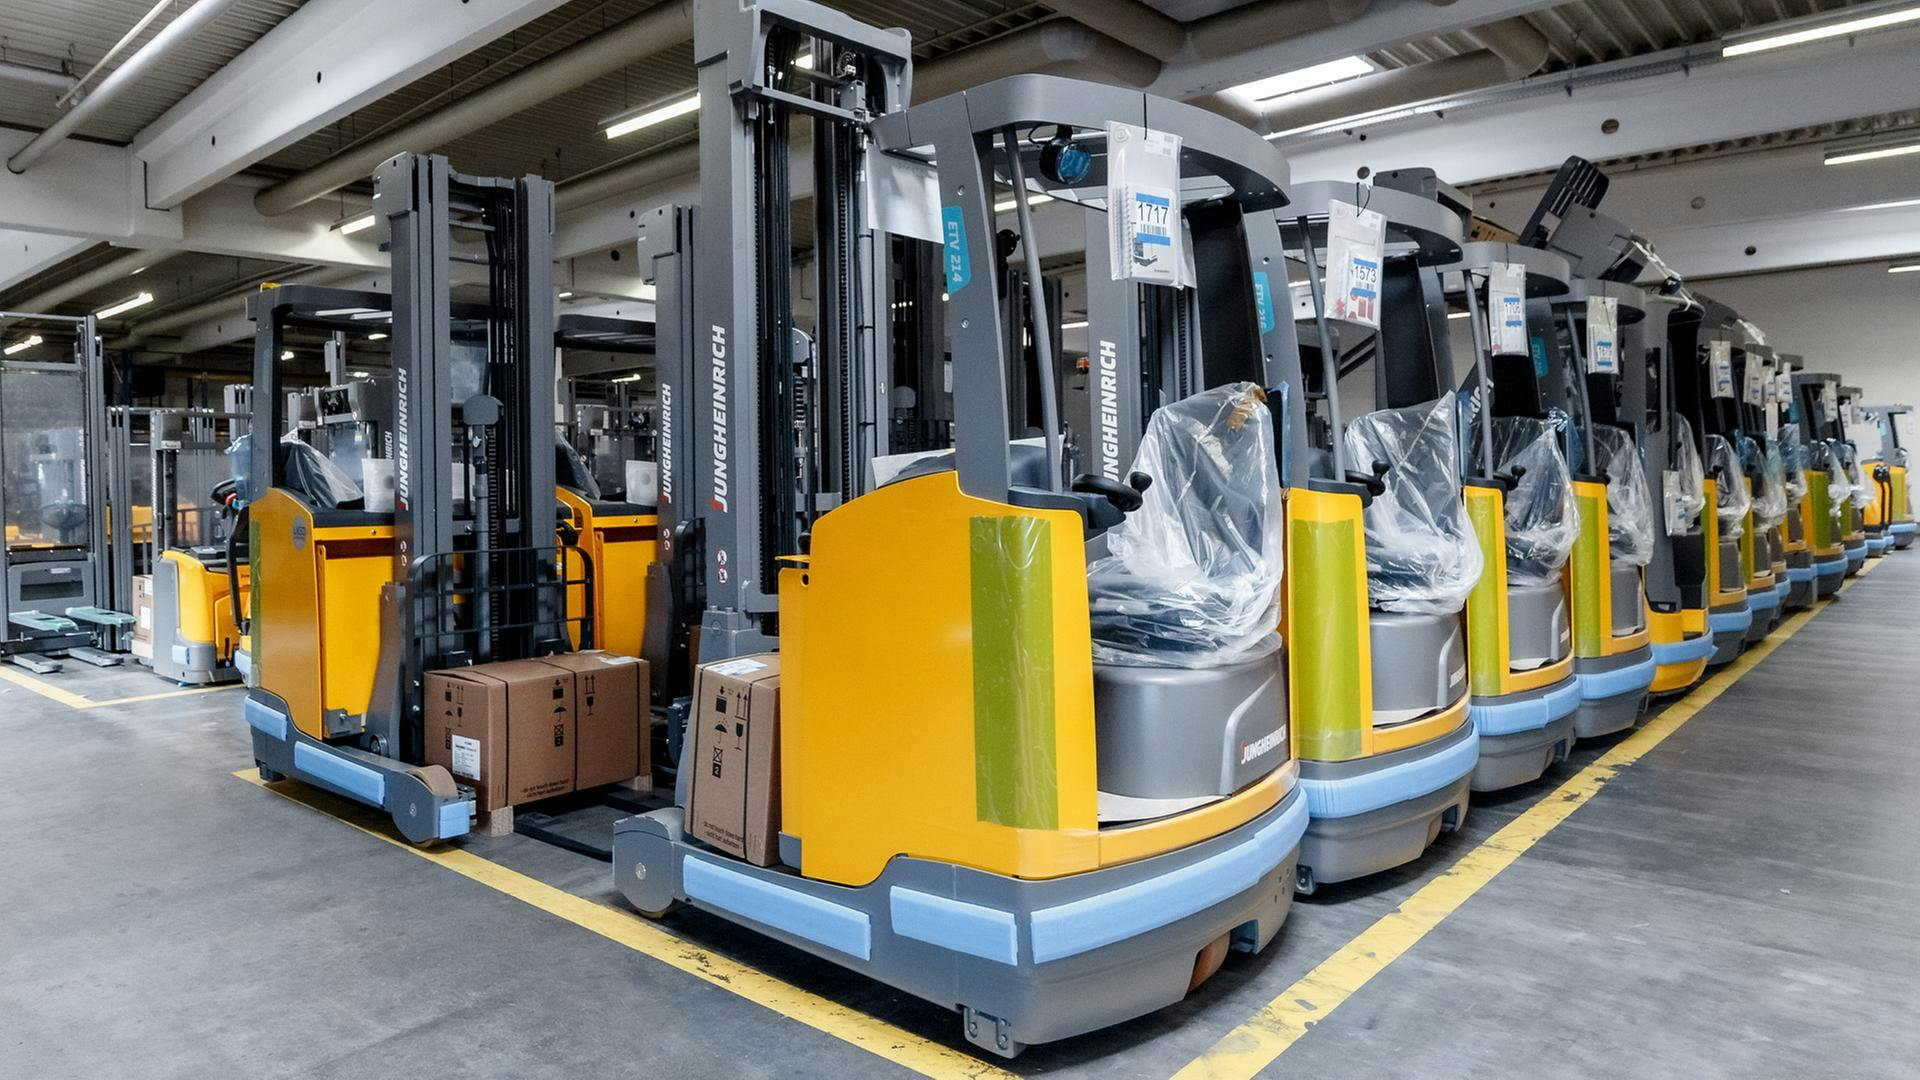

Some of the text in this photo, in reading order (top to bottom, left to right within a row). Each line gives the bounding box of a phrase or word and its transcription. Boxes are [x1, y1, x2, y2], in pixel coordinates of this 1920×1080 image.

[948, 221, 963, 282] ETV 214
[1138, 203, 1168, 225] 1717
[1355, 265, 1377, 283] 1573
[398, 367, 409, 511] JUNGHEINRICH
[660, 383, 672, 503] JUNGHEINRICH
[710, 324, 729, 513] JUNGHEINRICH
[1100, 340, 1120, 482] NGHEINRICH
